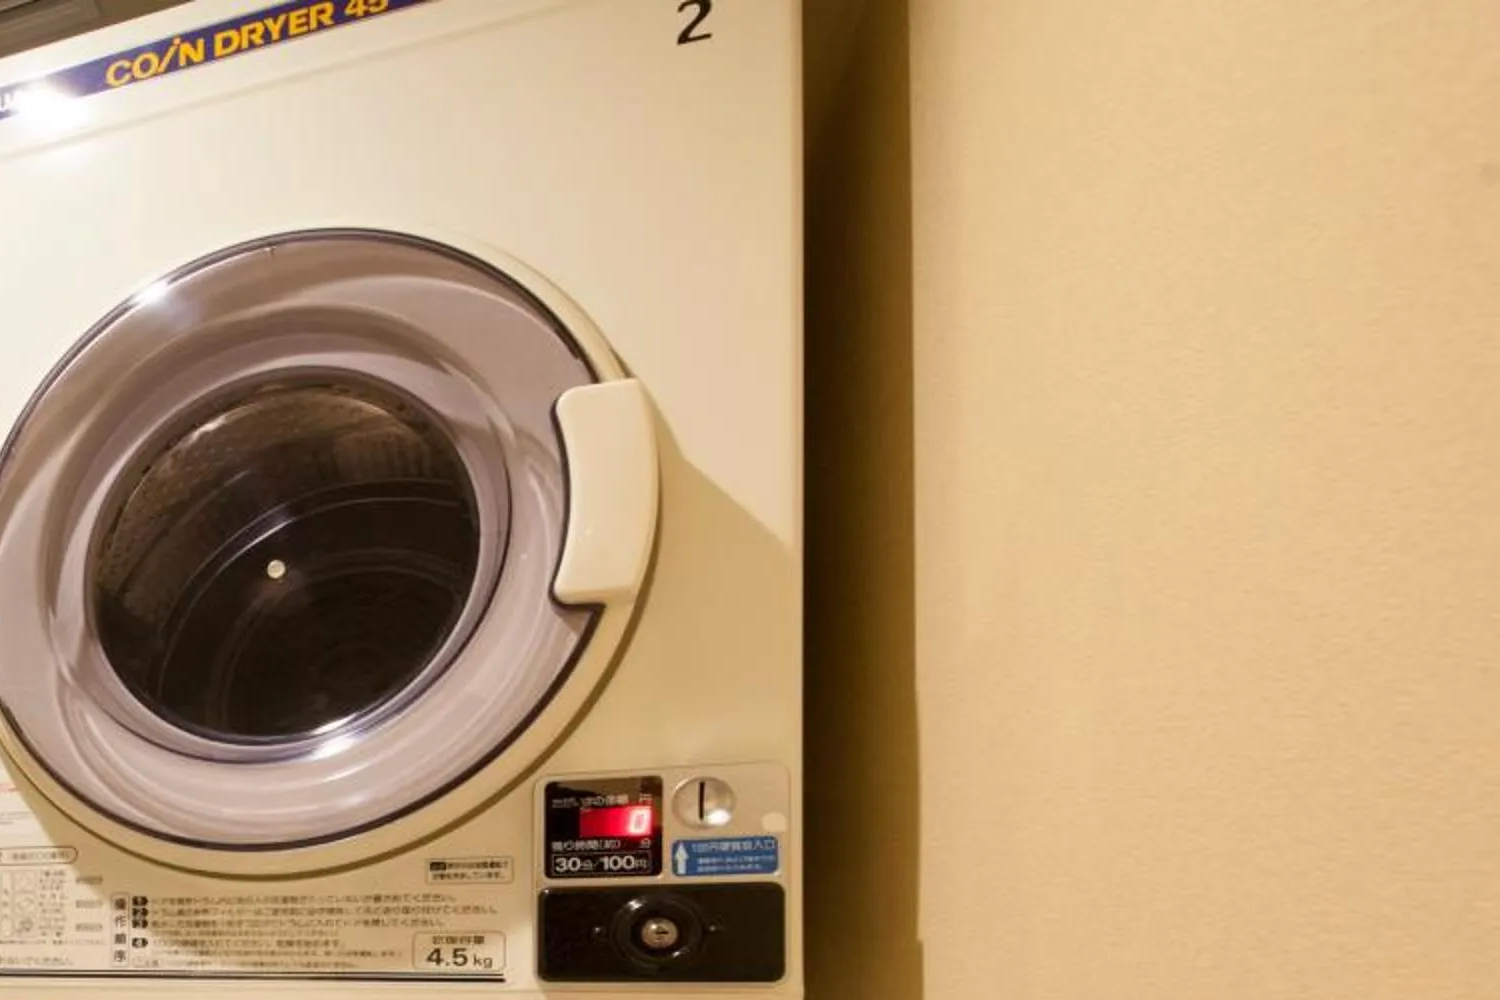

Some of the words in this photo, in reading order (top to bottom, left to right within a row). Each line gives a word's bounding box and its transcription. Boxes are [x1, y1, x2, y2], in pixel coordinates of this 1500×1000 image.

[214, 1, 335, 58] DRYER
[677, 0, 712, 45] 2
[426, 948, 468, 967] 4.5
[474, 953, 493, 969] kg
